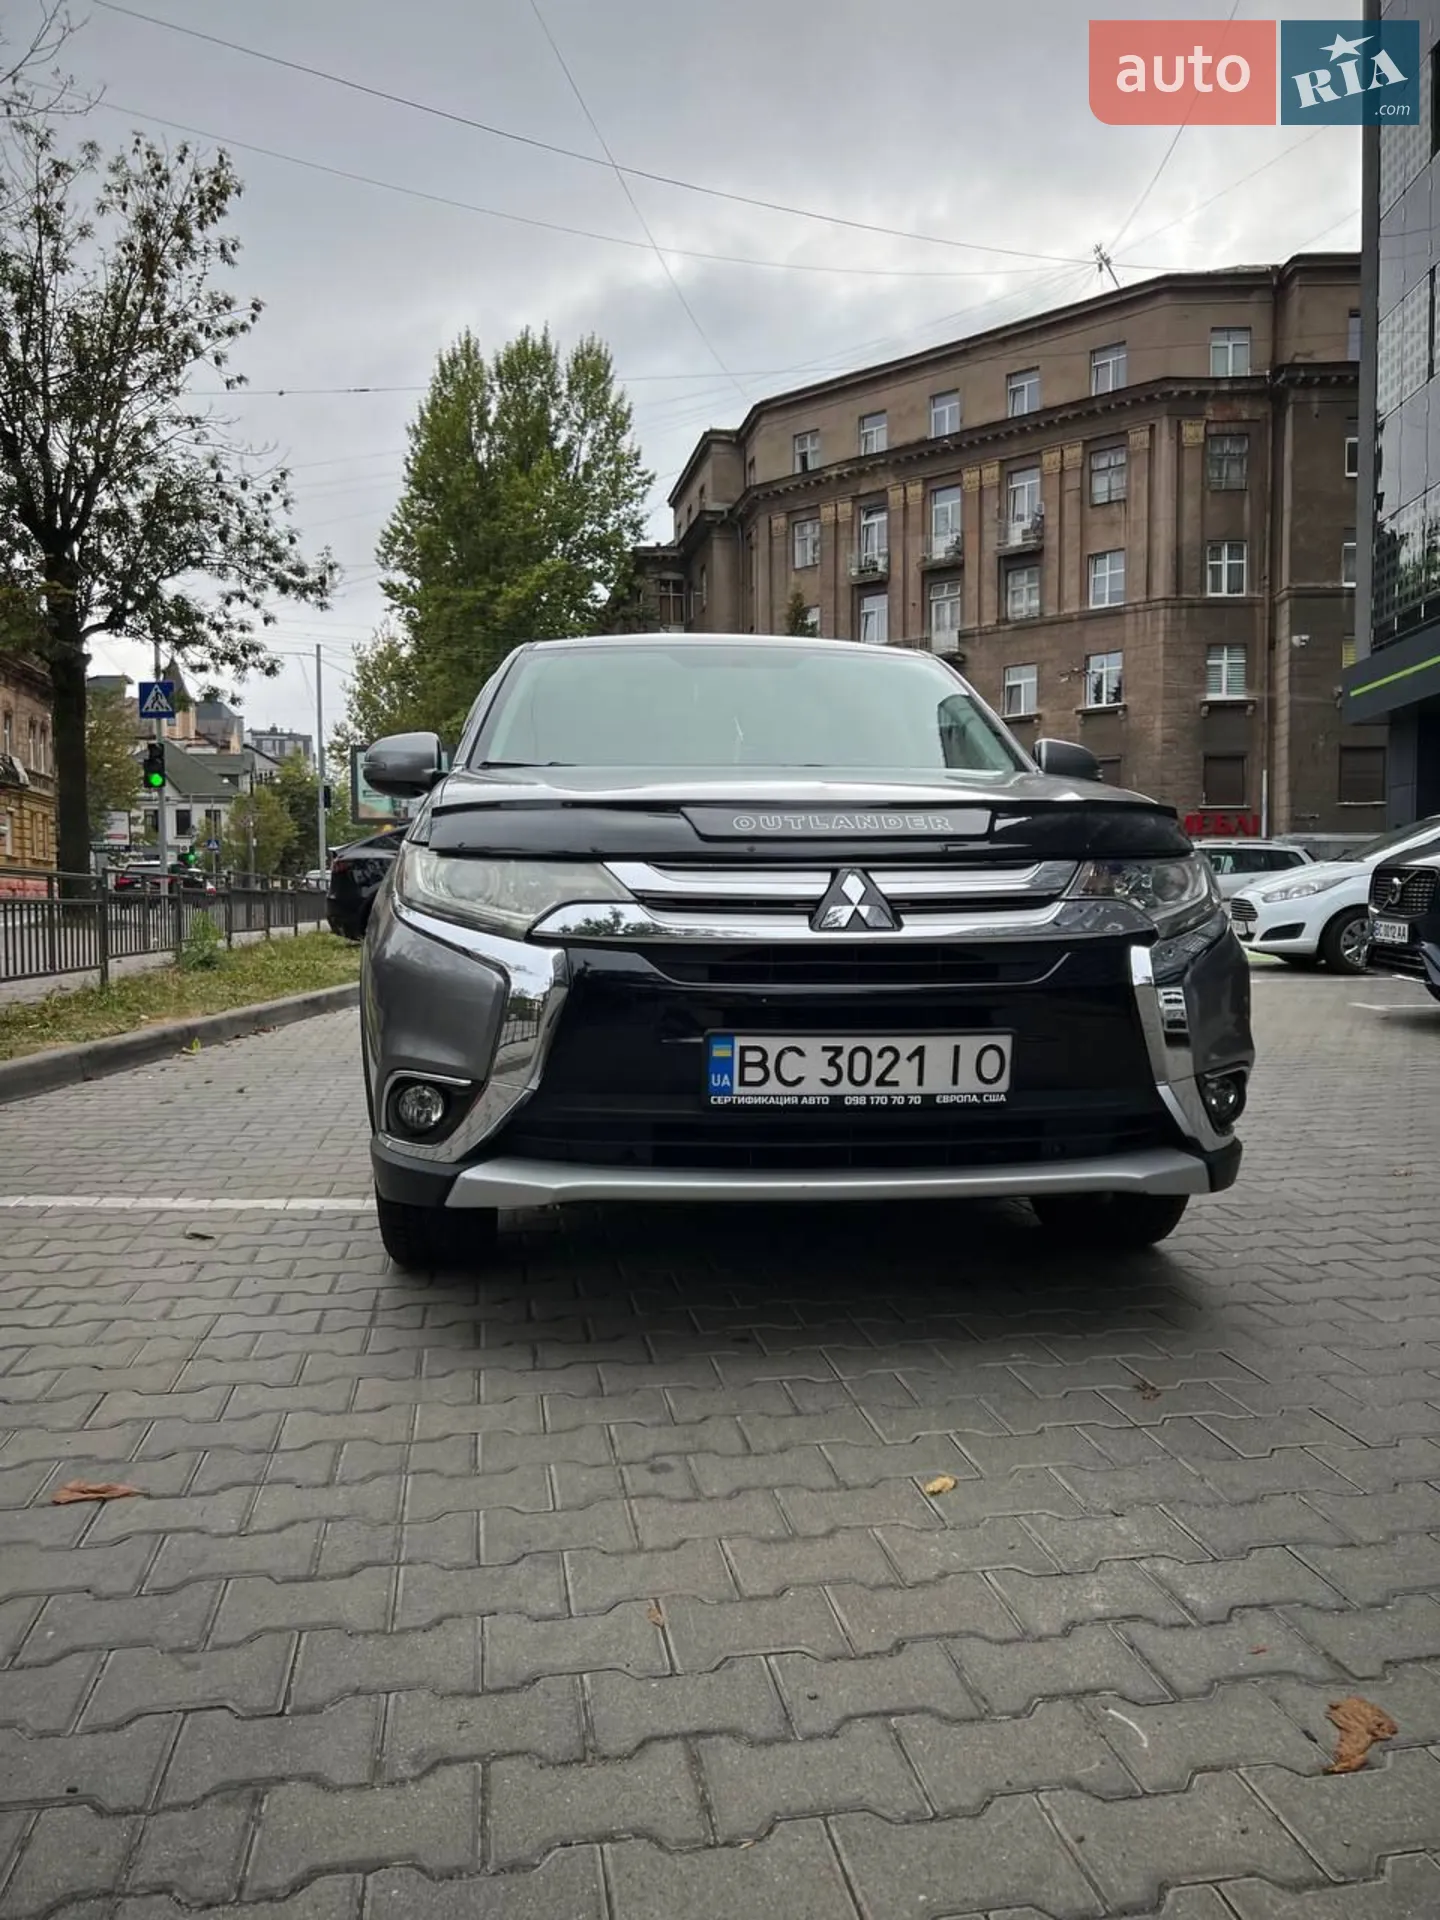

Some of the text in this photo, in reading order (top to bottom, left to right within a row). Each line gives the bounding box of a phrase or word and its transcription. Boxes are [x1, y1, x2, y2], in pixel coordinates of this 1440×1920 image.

[733, 815, 954, 832] OUTLANDER
[711, 1043, 1007, 1088] UA BC 3021 IO
[710, 1096, 799, 1106] СЕРТИФИКАЦИЯ
[800, 1096, 830, 1105] АВТО
[844, 1095, 867, 1106] 098
[869, 1095, 888, 1106] 170
[890, 1095, 905, 1105] 70
[907, 1095, 922, 1105] 70
[982, 1093, 1007, 1103] США
